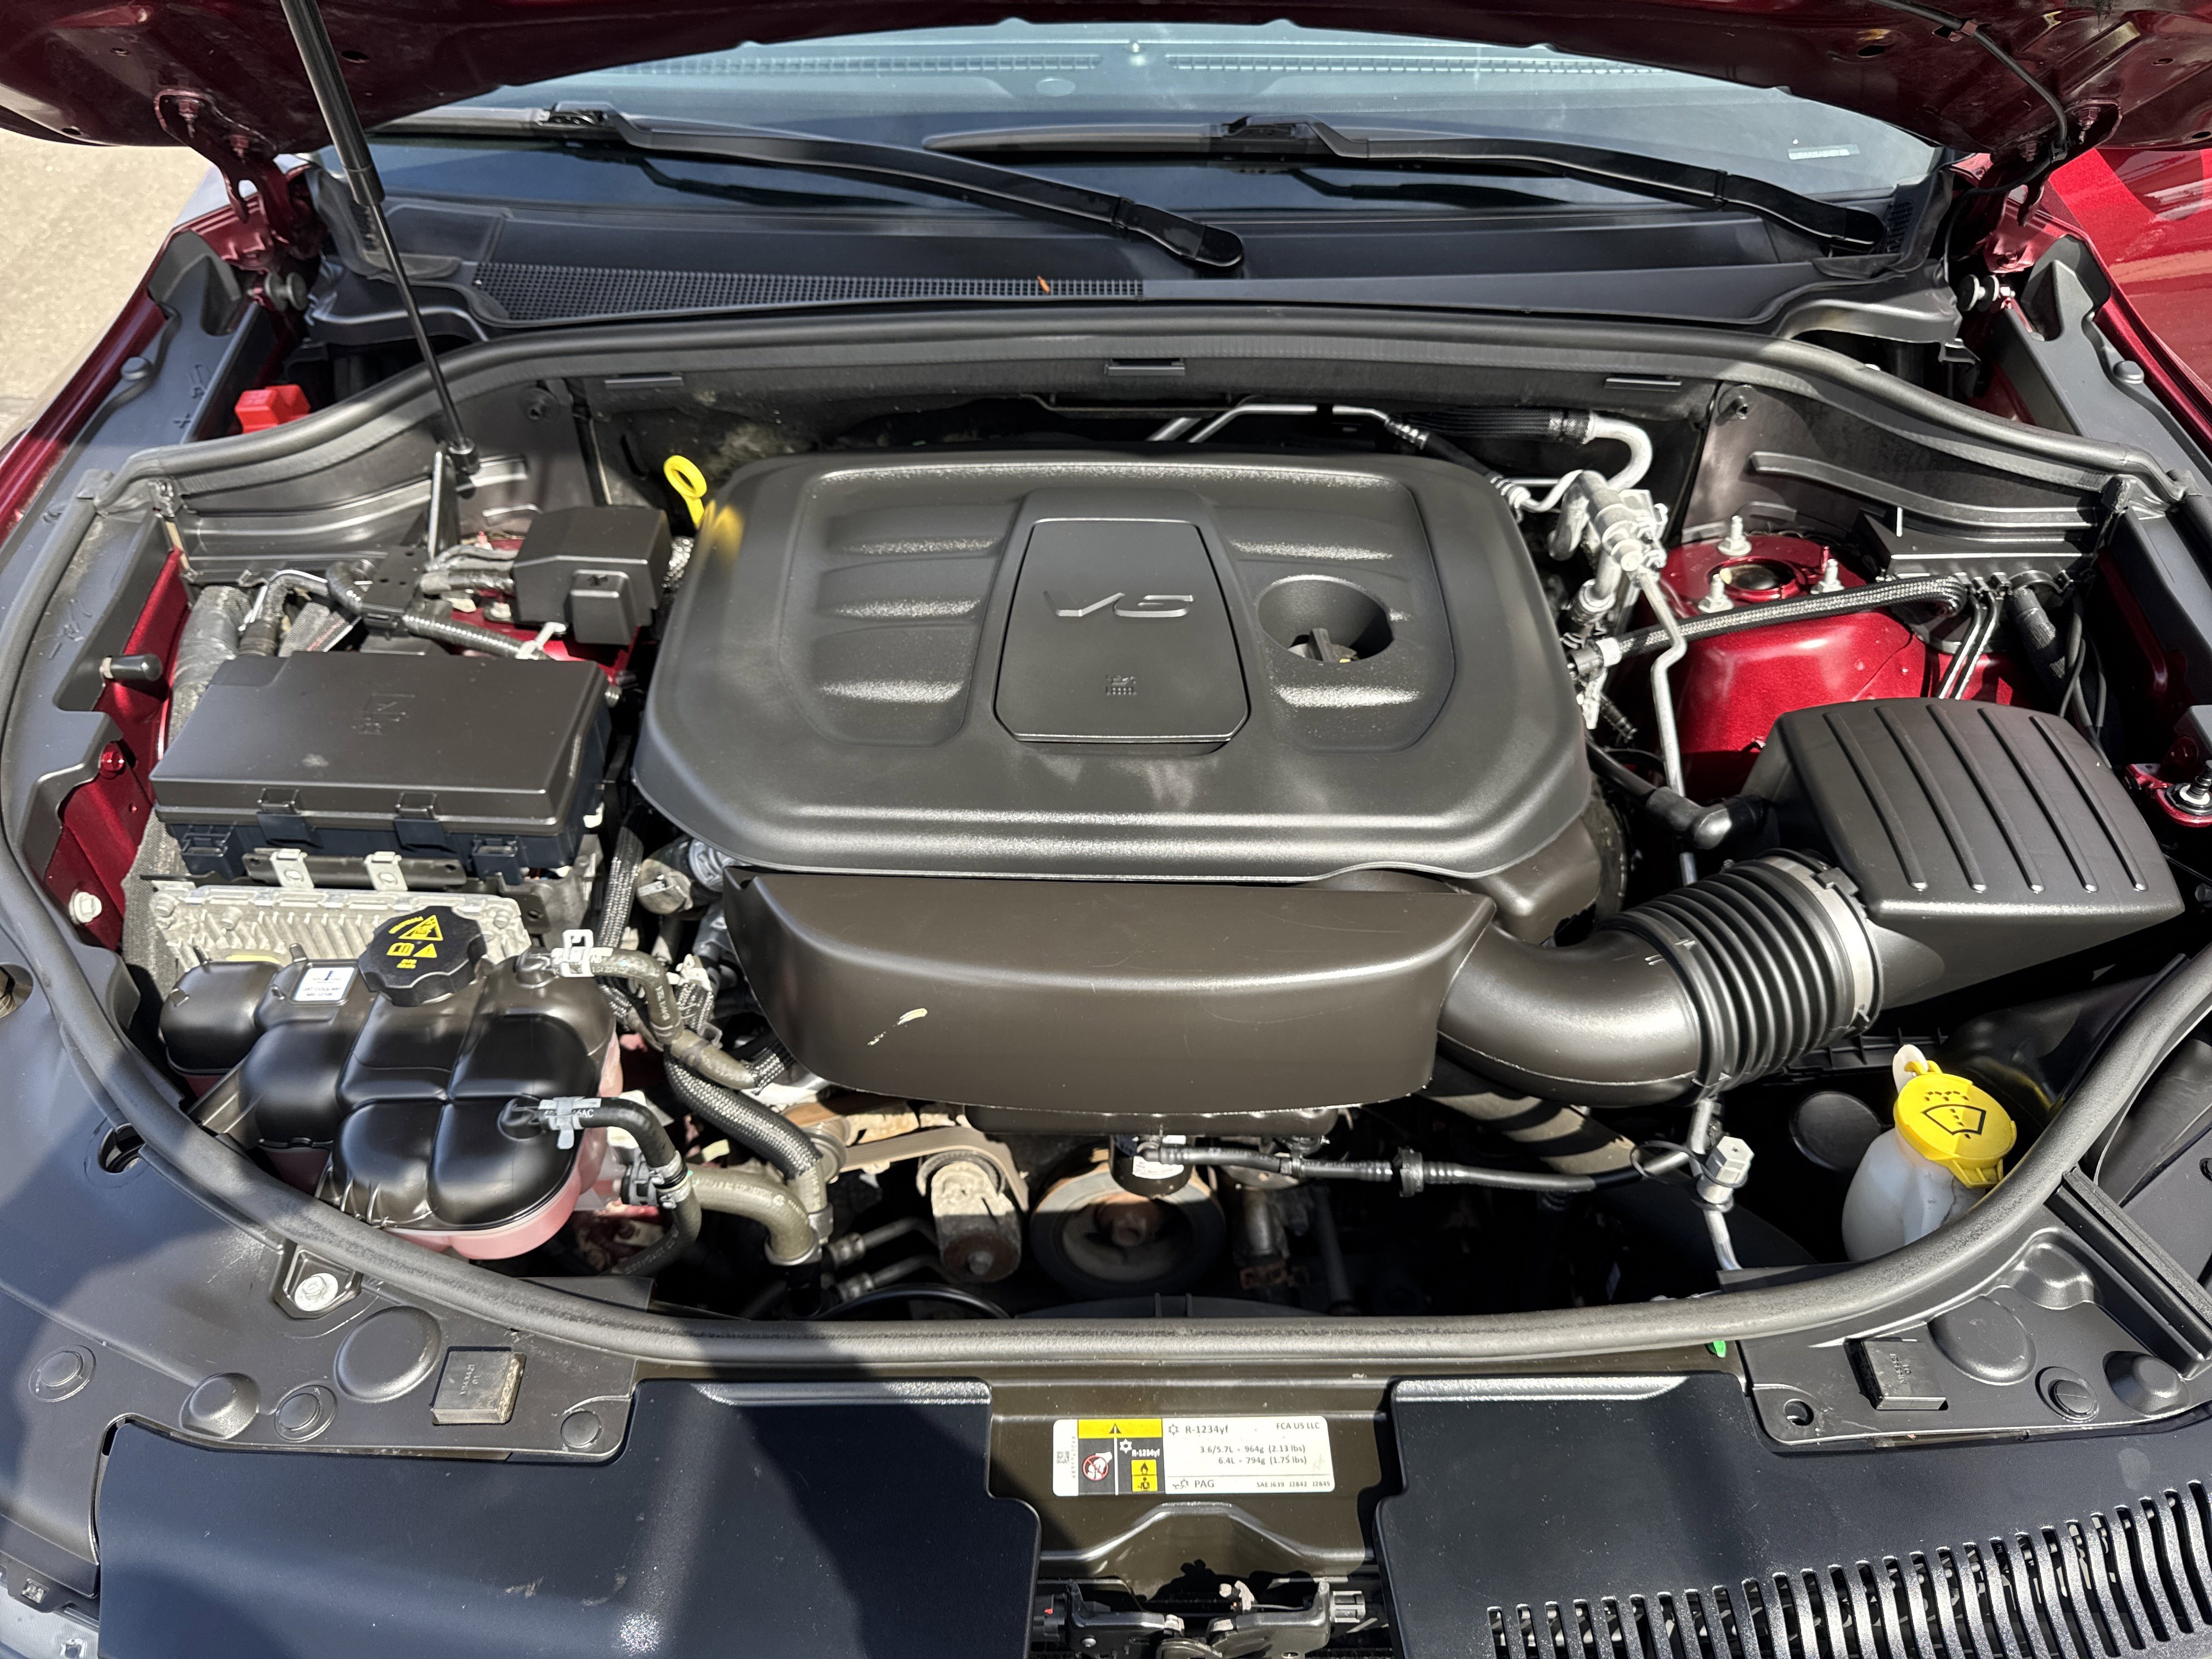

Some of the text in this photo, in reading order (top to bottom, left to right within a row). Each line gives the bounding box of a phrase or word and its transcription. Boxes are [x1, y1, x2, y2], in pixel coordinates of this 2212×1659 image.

[1042, 590, 1195, 618] V6
[1186, 1424, 1228, 1435] R-1234yf
[1131, 1448, 1160, 1458] R-1234yf
[1200, 1445, 1233, 1454] 3.6/5.7L
[1244, 1446, 1264, 1454] 964g
[1268, 1444, 1289, 1454] (2.13
[1291, 1444, 1306, 1453] lbs)
[1246, 1457, 1266, 1465] 794g
[1269, 1454, 1290, 1465] (1.75
[1292, 1455, 1307, 1465] lbs)
[1194, 1480, 1215, 1488] PAG
